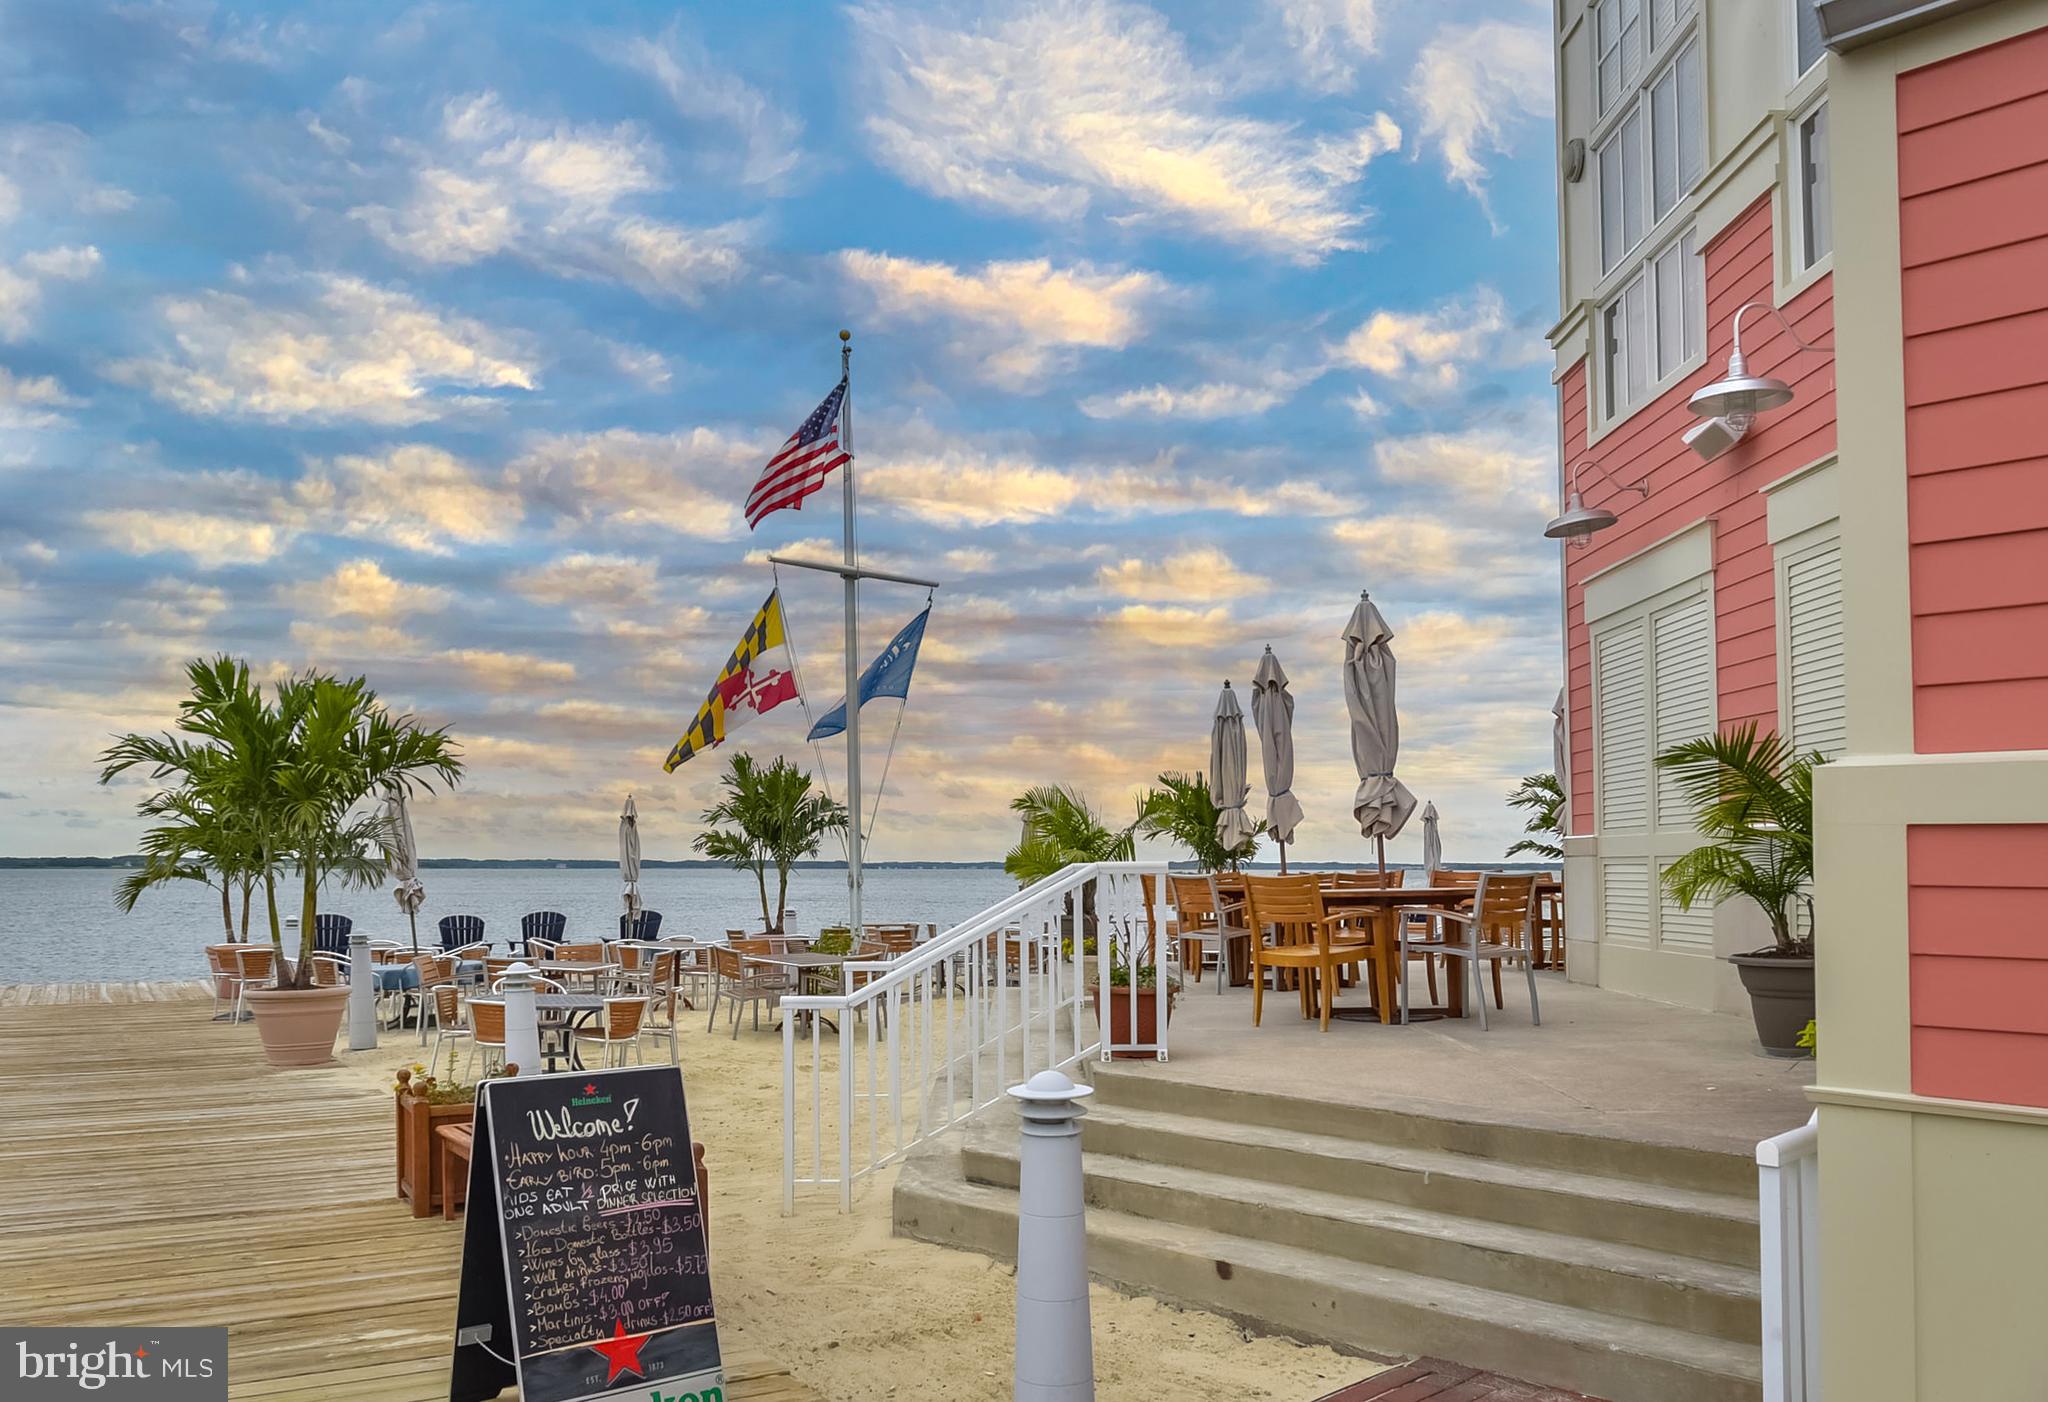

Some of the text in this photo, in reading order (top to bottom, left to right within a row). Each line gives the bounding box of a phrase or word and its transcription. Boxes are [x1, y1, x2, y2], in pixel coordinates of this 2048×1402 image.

[571, 1096, 612, 1106] Heineken
[526, 1098, 640, 1141] Welcome!
[600, 1139, 631, 1162] 4pm
[546, 1187, 574, 1201] EAT
[645, 1175, 676, 1189] WITH
[504, 1205, 534, 1219] ONE
[542, 1200, 589, 1215] ADULT
[597, 1193, 639, 1210] DINNER
